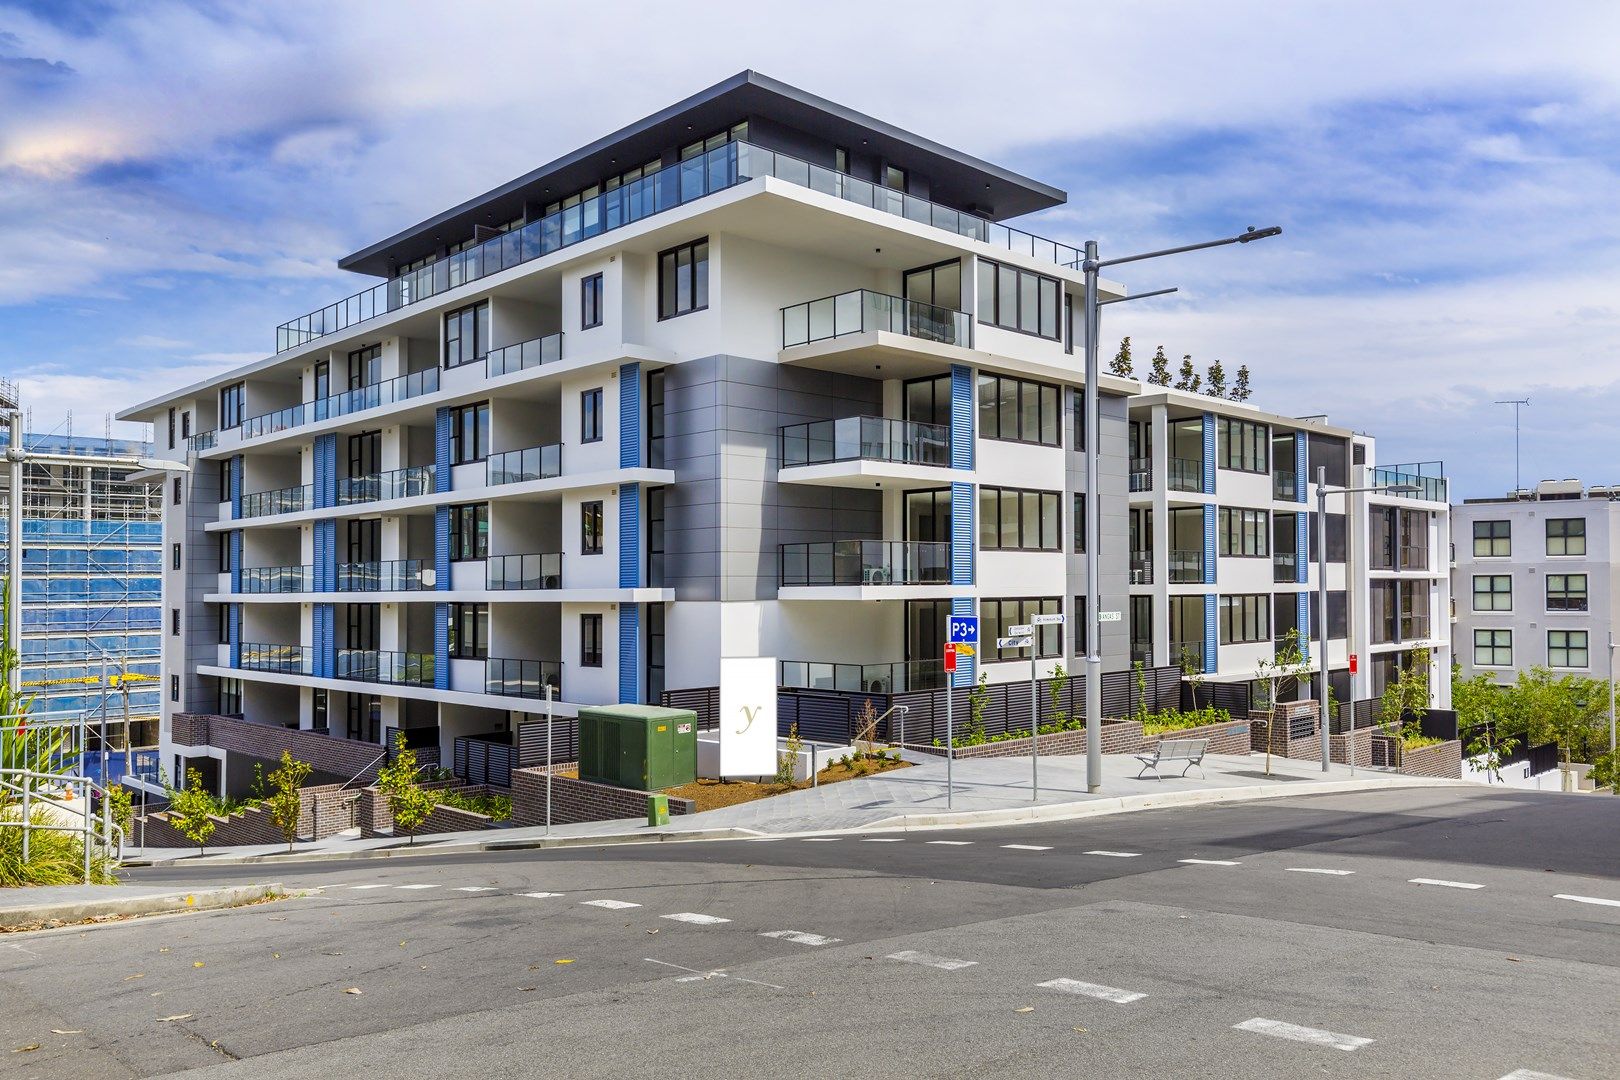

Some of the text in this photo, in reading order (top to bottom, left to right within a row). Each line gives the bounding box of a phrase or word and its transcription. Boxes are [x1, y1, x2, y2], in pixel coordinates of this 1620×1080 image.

[952, 622, 968, 637] P3
[1007, 639, 1019, 647] City
[735, 705, 762, 735] y
